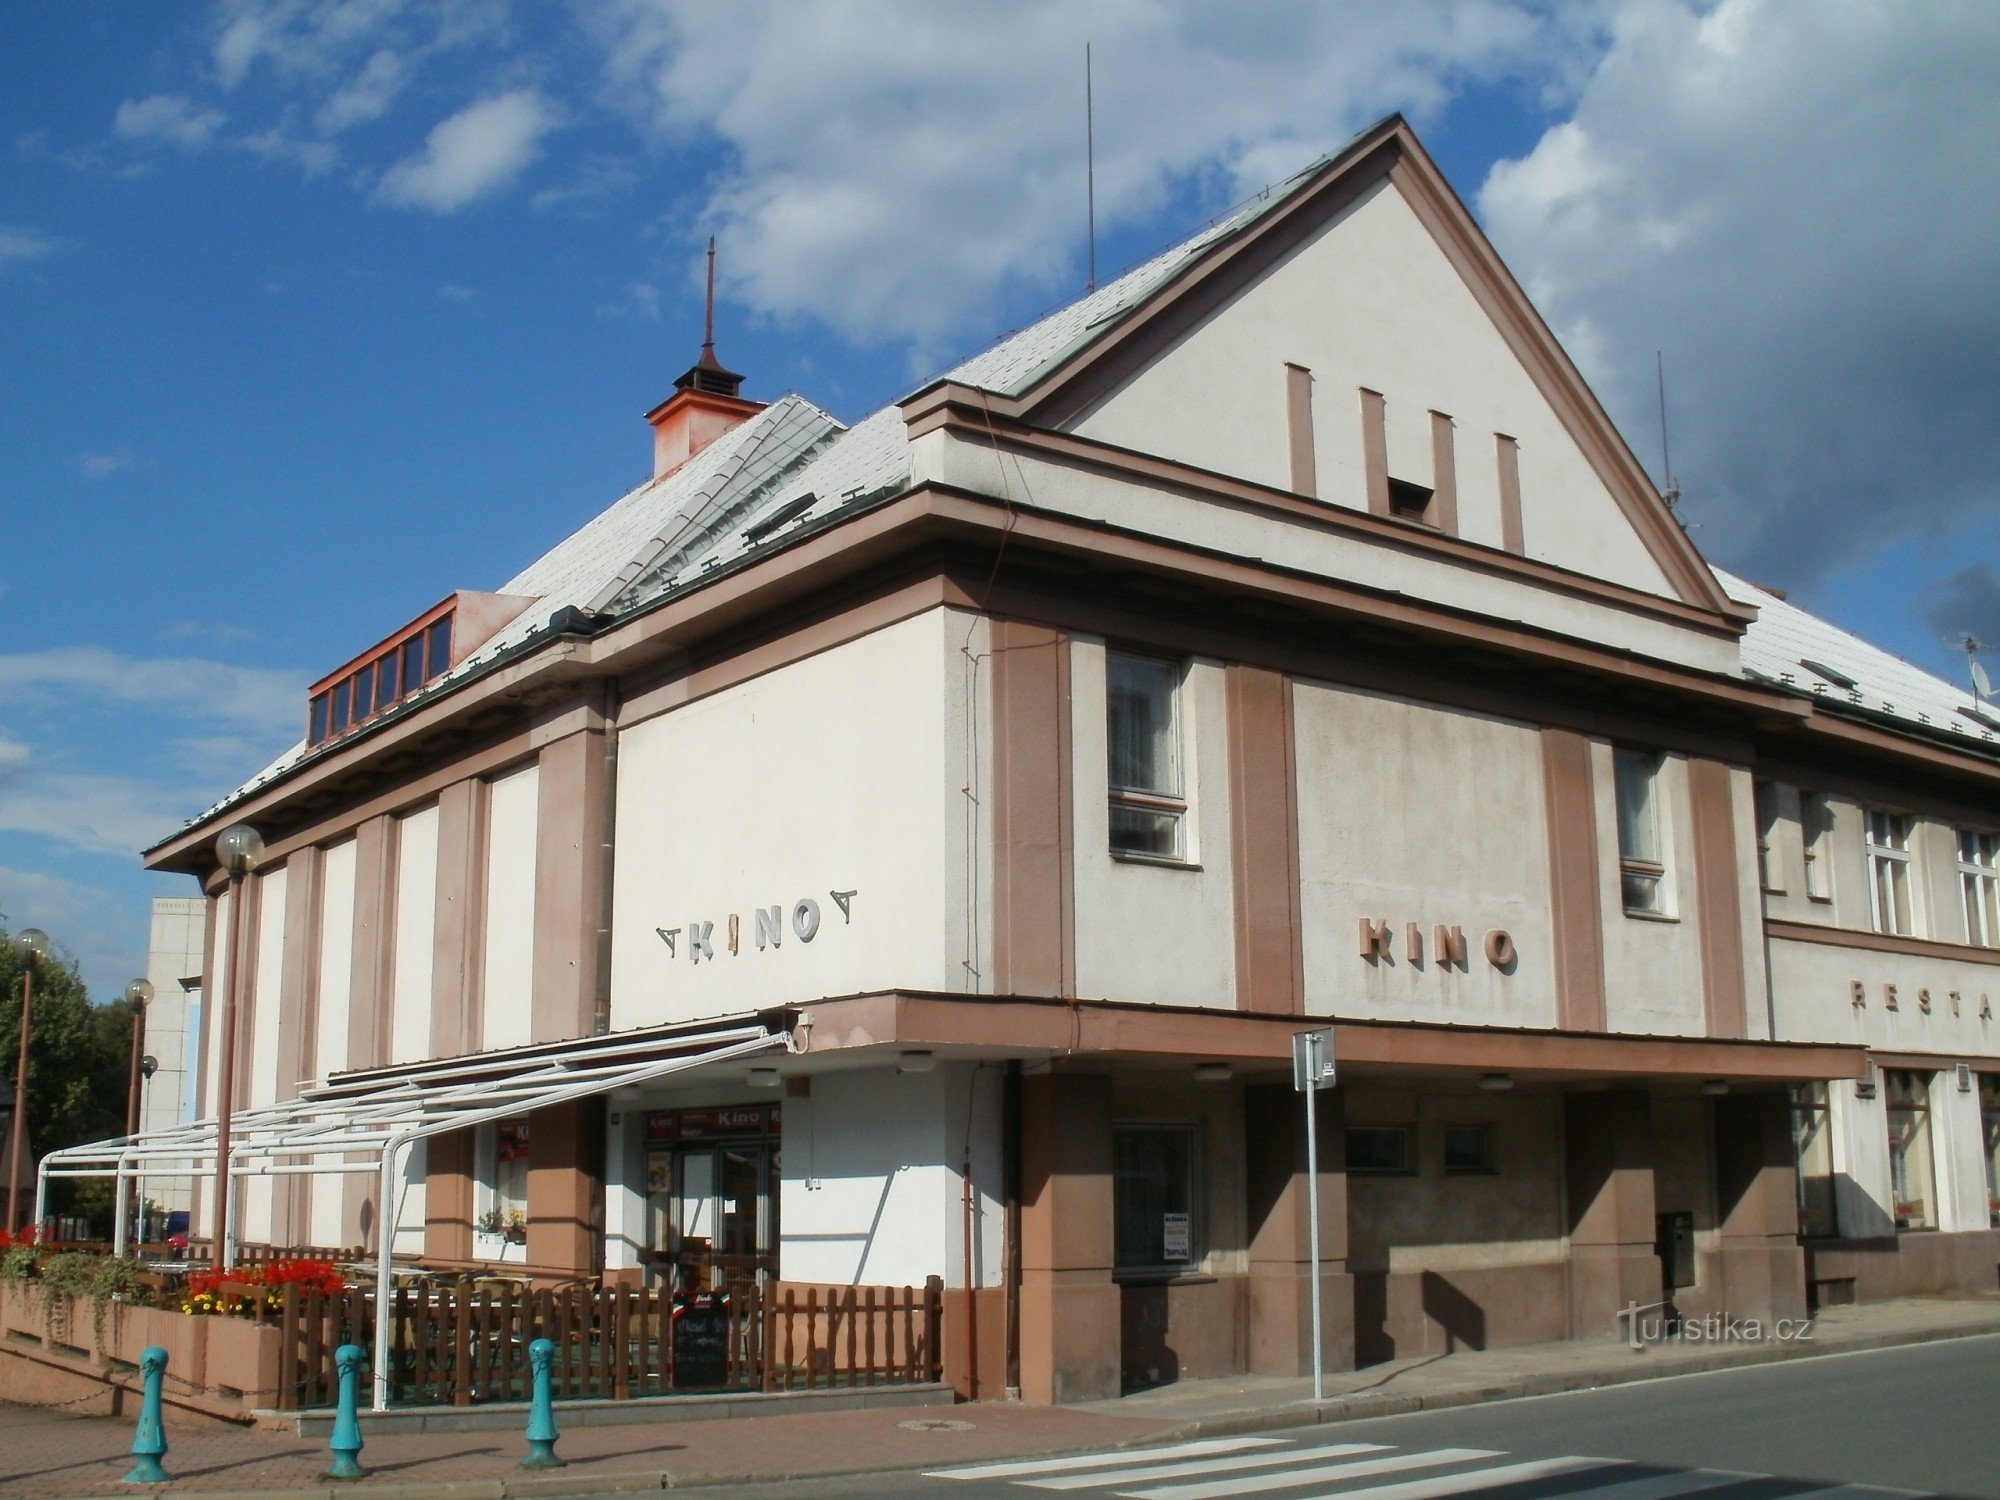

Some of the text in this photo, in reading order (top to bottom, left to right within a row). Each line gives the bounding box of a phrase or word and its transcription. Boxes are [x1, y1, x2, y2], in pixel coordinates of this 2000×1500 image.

[689, 898, 821, 965] KINO
[1358, 917, 1517, 974] KINO
[1850, 980, 1992, 1020] RESTA
[718, 1111, 761, 1126] Kino
